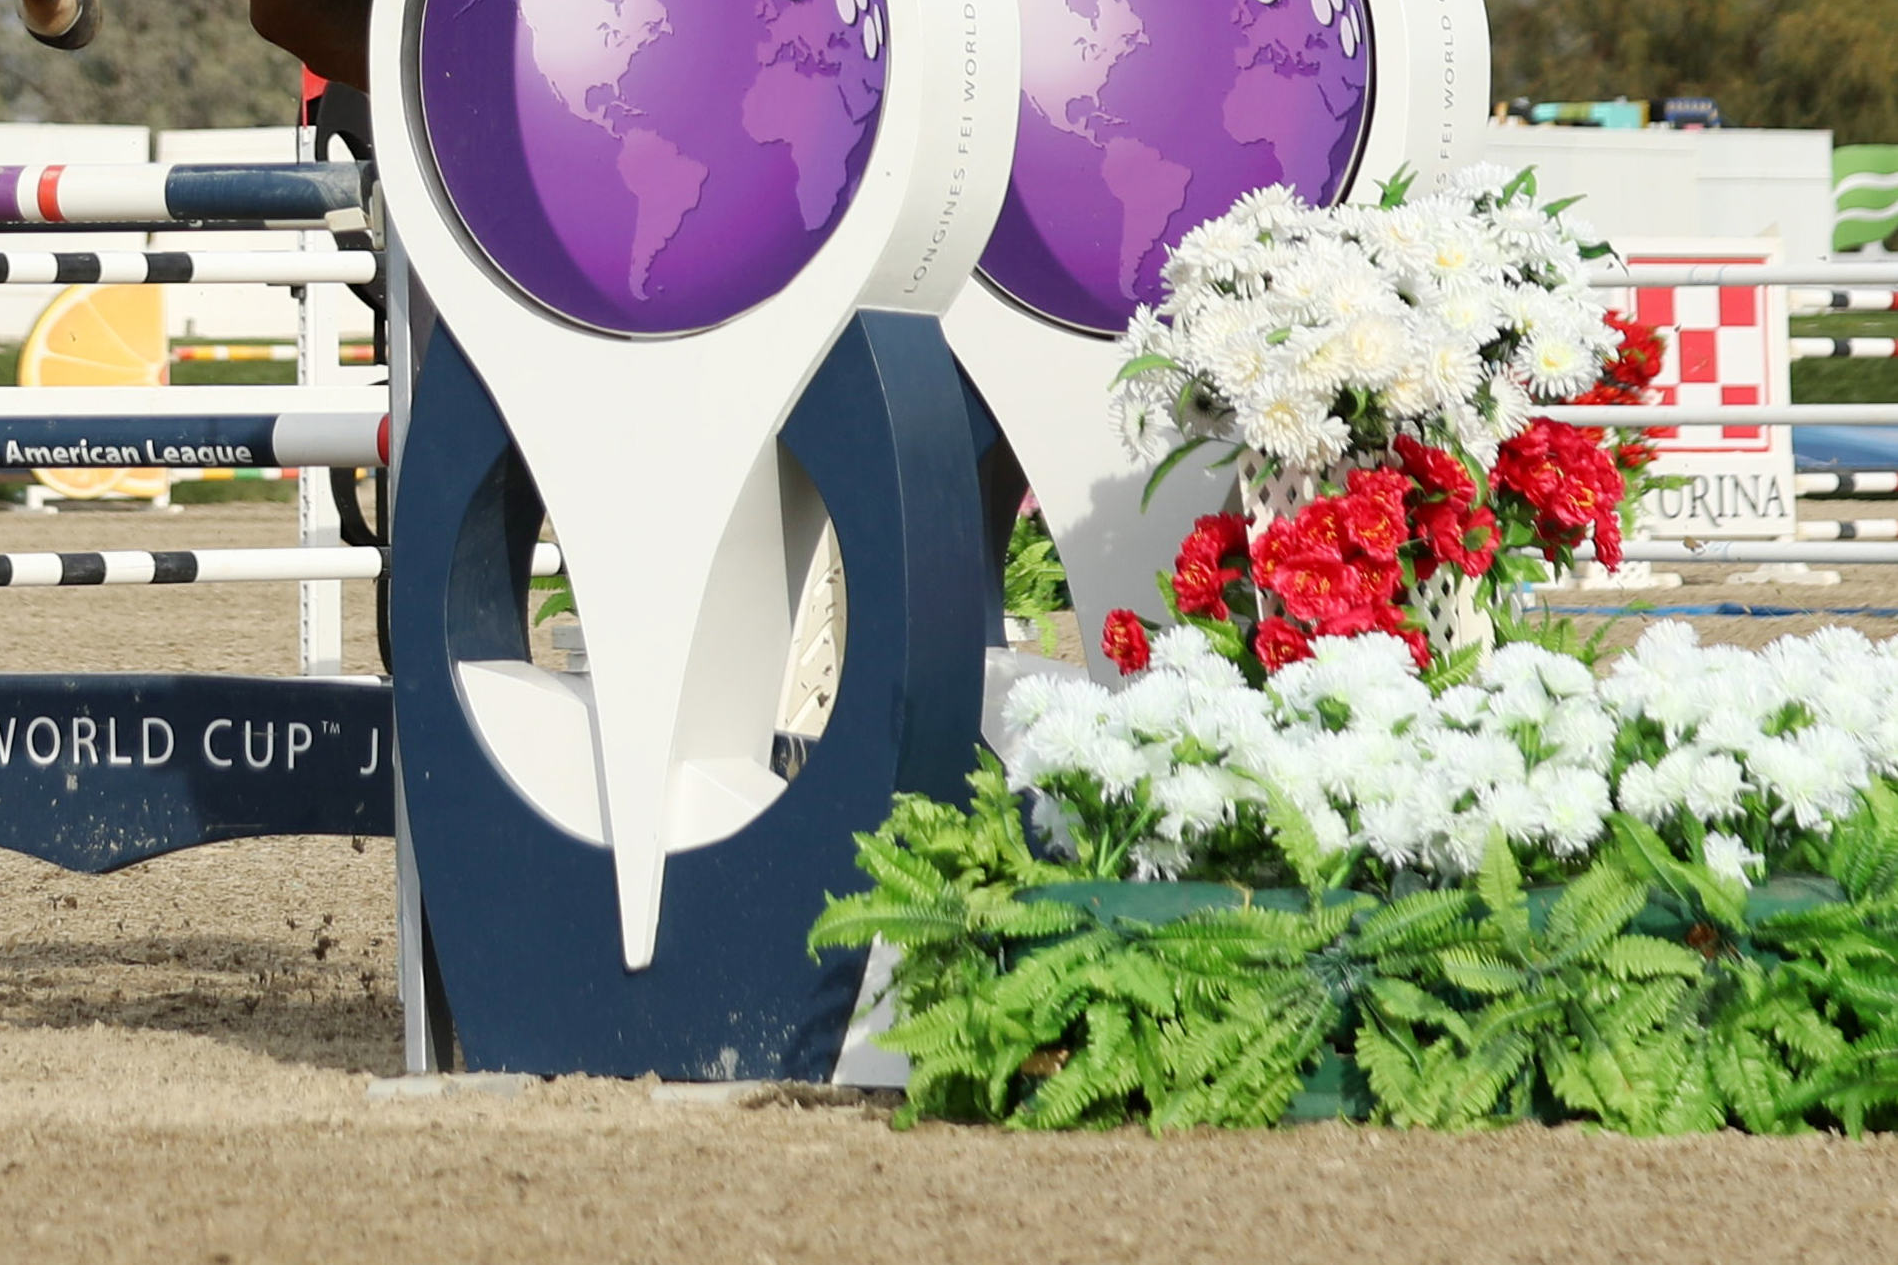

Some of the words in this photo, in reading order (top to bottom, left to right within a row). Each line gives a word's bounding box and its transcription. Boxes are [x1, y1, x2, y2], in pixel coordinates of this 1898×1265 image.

[962, 2, 977, 102] WORLD
[1440, 14, 1455, 109] WORLD
[957, 115, 973, 154] FEI
[1440, 121, 1453, 159] FEI
[903, 166, 967, 295] LONGINES
[5, 438, 141, 465] American
[145, 438, 253, 466] League
[1658, 473, 1789, 528] URINA
